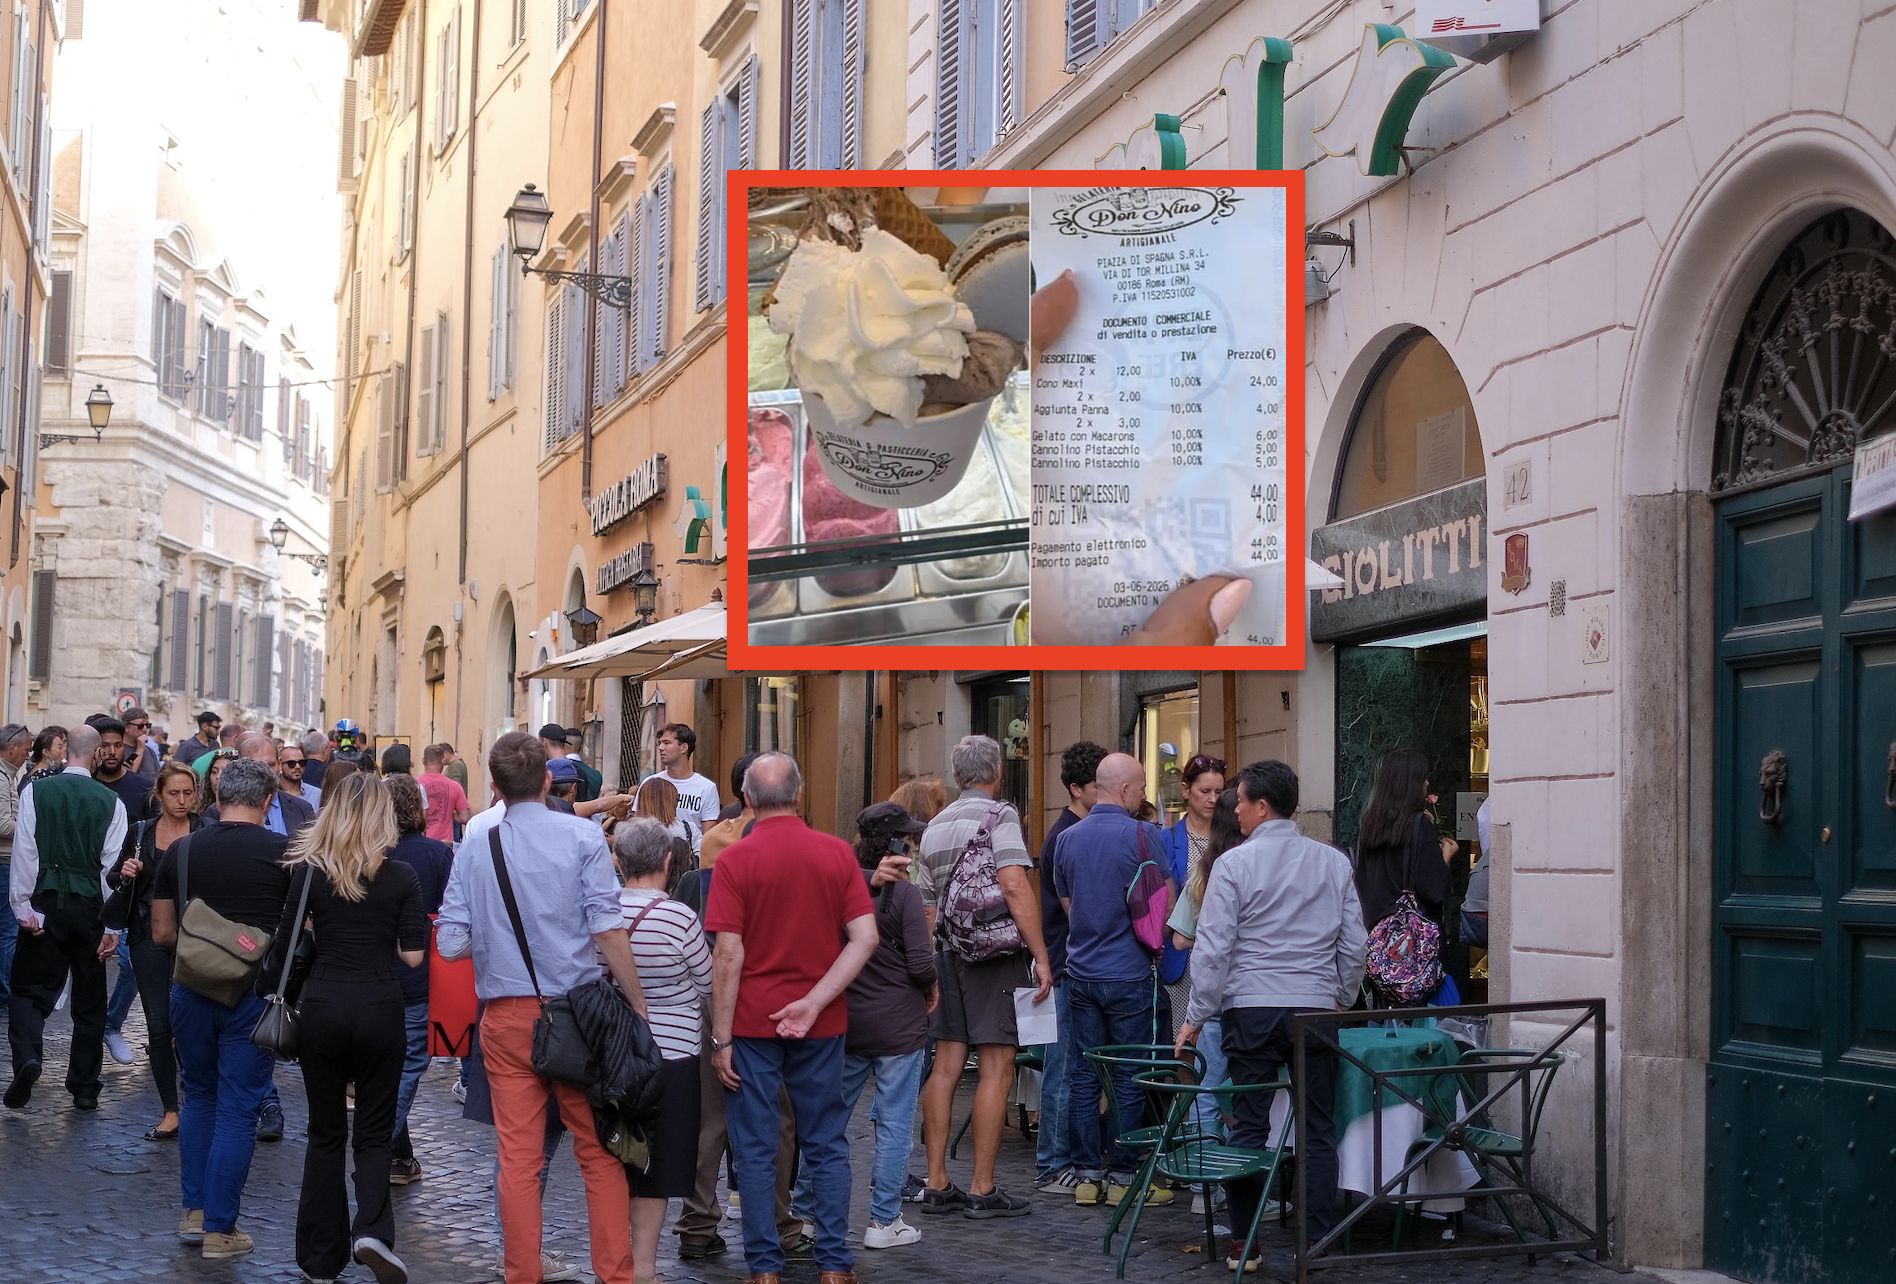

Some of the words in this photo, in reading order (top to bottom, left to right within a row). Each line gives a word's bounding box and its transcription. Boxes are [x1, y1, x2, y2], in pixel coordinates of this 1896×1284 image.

[1089, 208, 1137, 227] Don
[1143, 198, 1202, 219] Nino
[1120, 233, 1176, 247] ARTIGIANALE
[1097, 257, 1127, 268] PIAZZA
[1131, 255, 1141, 266] DI
[1145, 252, 1175, 264] SPAGNA
[1179, 249, 1209, 261] S.R.L.
[1103, 270, 1121, 280] VIA
[1122, 269, 1131, 278] DI
[1136, 268, 1151, 277] TOR
[1155, 264, 1190, 276] MILLINA
[1195, 261, 1205, 270] 34
[1117, 280, 1141, 290] 00186
[1146, 278, 1165, 289] Roma
[1170, 276, 1190, 287] (RM)
[1113, 293, 1137, 303] P.IVA
[1141, 287, 1195, 301] 11520531002
[1102, 316, 1147, 328] DOCUMENTO
[1156, 311, 1212, 325] COMMERCIALE
[1097, 329, 1108, 339] di
[1113, 327, 1147, 339] vendita
[1151, 330, 1157, 338] o
[1162, 324, 1216, 338] prestazione
[1040, 354, 1096, 364] DESCRIZIONE
[1181, 351, 1196, 361] IVA
[1227, 349, 1276, 361] Prezzo(€)
[1079, 367, 1085, 376] 2
[1116, 366, 1141, 376] 12,00
[1037, 379, 1059, 388] Cono
[1062, 378, 1083, 388] Maxi
[1170, 377, 1202, 387] 10,00%
[1250, 376, 1277, 387] 24,00
[1077, 392, 1083, 401] 2
[1119, 392, 1141, 402] 2,00
[1034, 405, 1077, 418] Aggiunta
[1082, 404, 1109, 415] Panna
[1171, 402, 1202, 413] 10,00%
[1256, 403, 1278, 413] 4,00
[1077, 418, 1083, 427] 2
[1119, 418, 1141, 428] 3,00
[1032, 431, 1066, 441] Gelato
[1071, 433, 1088, 441] con
[1092, 431, 1135, 441] Macarons
[1171, 430, 1202, 440] 10,00%
[1256, 430, 1277, 440] 6,00
[877, 444, 929, 457] PASTICCERIA
[1032, 445, 1081, 455] Cannolino
[1085, 444, 1140, 455] Pistacchio
[1172, 443, 1202, 453] 10,00%
[1256, 444, 1277, 453] 5,00
[835, 451, 873, 474] Don
[875, 461, 924, 480] Nino
[1032, 458, 1081, 468] Cannolino
[1085, 458, 1140, 468] Pistacchio
[1172, 456, 1202, 466] 10,00%
[1256, 457, 1277, 467] 5,00
[1506, 466, 1529, 504] 42
[591, 475, 629, 536] PICCOLA
[629, 452, 659, 512] ROMA
[1033, 485, 1066, 503] TOTALE
[1070, 485, 1130, 503] COMPLESSIVO
[1250, 484, 1278, 502] 44,00
[1032, 507, 1043, 526] di
[1049, 508, 1065, 525] cui
[1071, 506, 1087, 523] IVA
[1256, 505, 1277, 523] 4,00
[1031, 542, 1081, 554] Pagamento
[1087, 539, 1147, 551] elettronico
[1251, 537, 1277, 547] 44,00
[1031, 557, 1070, 568] Importo
[1075, 555, 1109, 567] pagato
[1251, 550, 1278, 561] 44,00
[1320, 514, 1482, 605] GIOLITTI
[1114, 582, 1169, 593] 03-06-2026
[1097, 595, 1148, 608] DOCUMENTO
[676, 793, 702, 812] HINO
